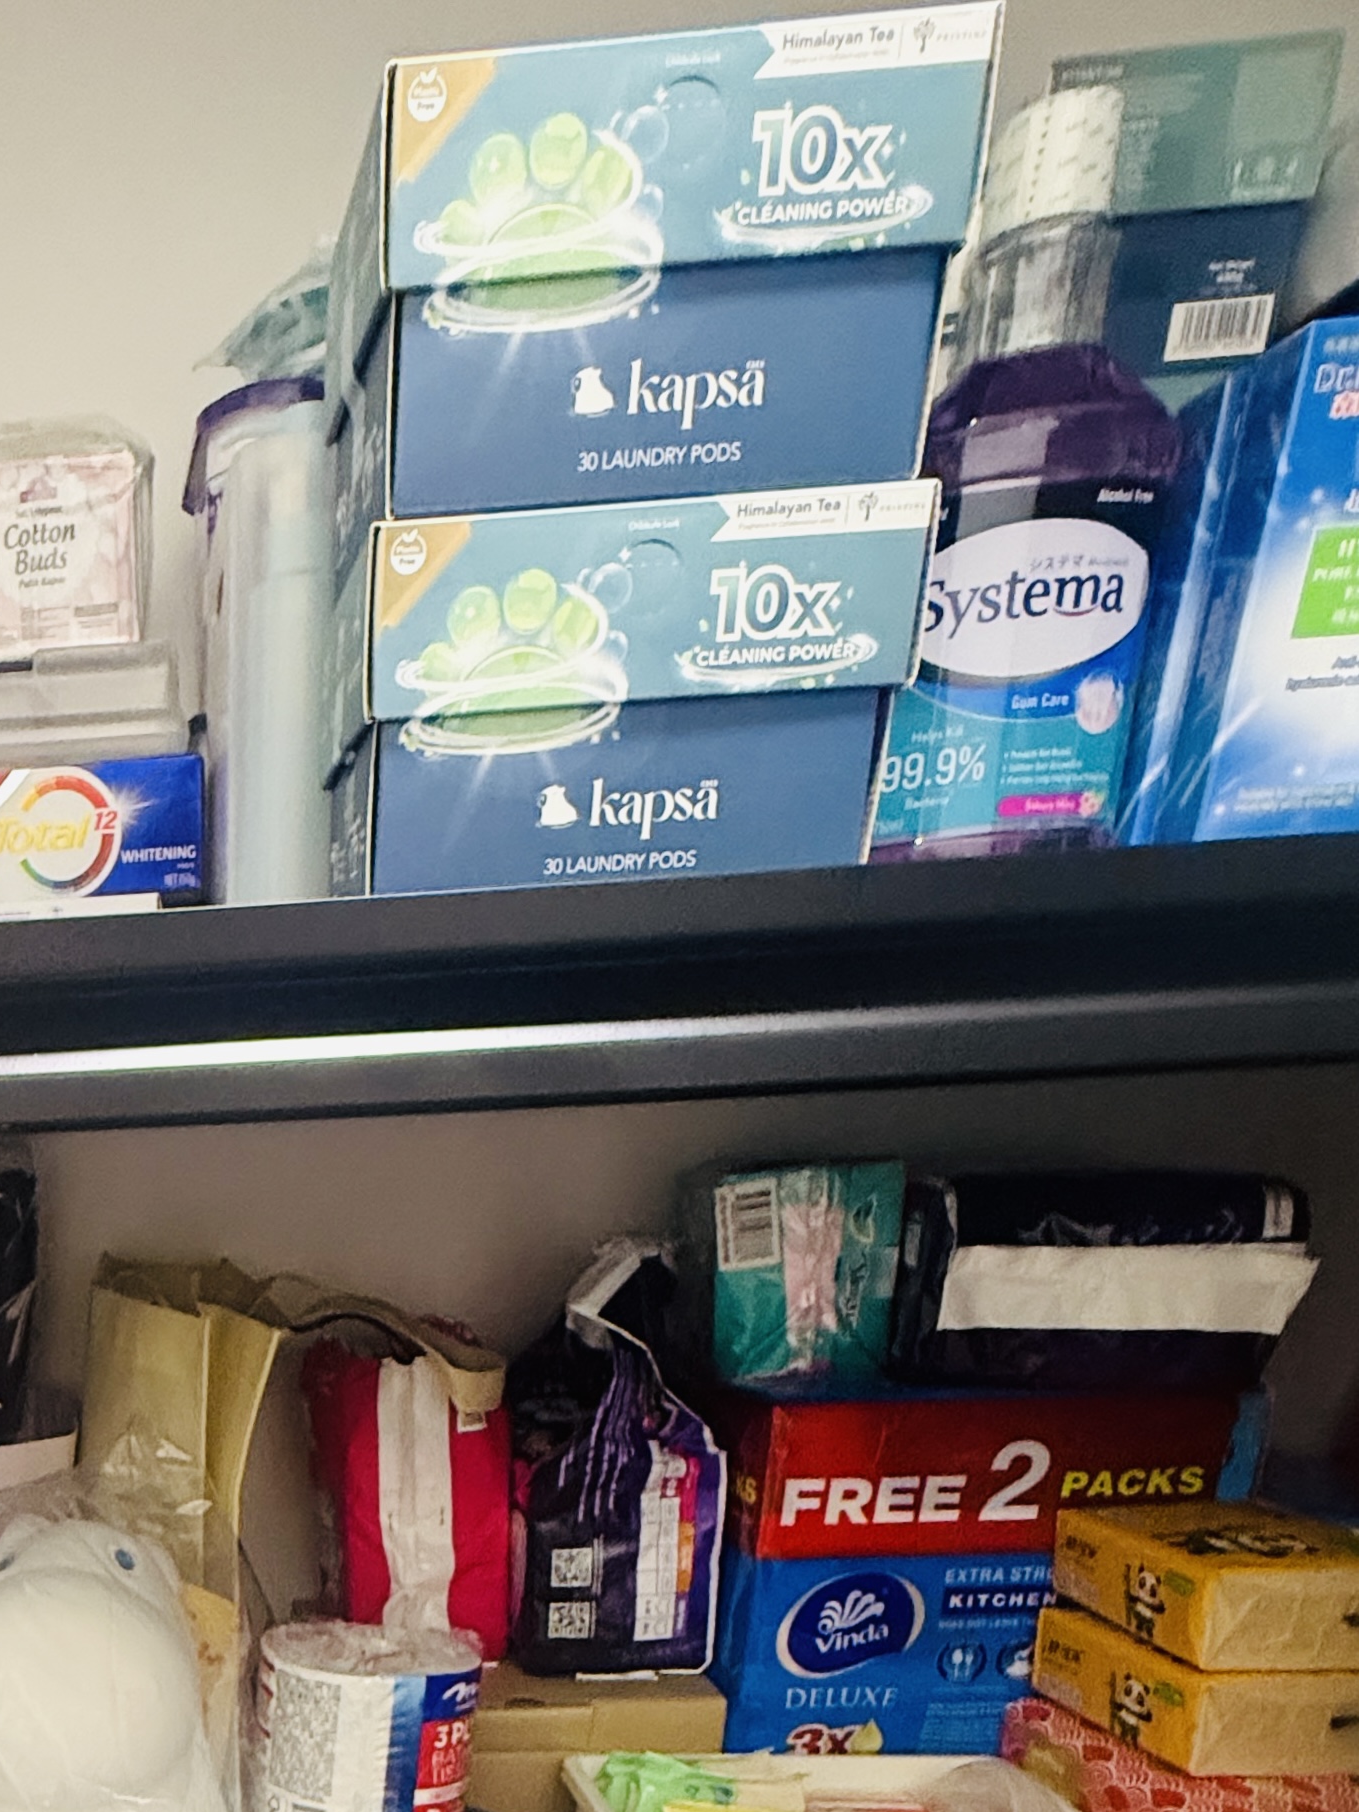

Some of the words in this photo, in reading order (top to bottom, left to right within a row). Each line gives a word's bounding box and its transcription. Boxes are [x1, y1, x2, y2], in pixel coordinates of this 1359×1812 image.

[782, 29, 863, 50] Himalayan
[869, 26, 895, 43] Tea
[752, 105, 893, 197] 10x
[737, 202, 833, 225] CLEANING
[836, 196, 910, 219] POWER
[577, 451, 599, 472] 30
[601, 445, 688, 471] LAUNDRY
[690, 441, 742, 464] PODS
[737, 499, 812, 519] Himalayan
[818, 498, 841, 511] Tea
[4, 523, 76, 550] Cotton
[14, 547, 67, 575] Buds
[710, 564, 842, 642] 10x
[924, 570, 1124, 640] Systema
[696, 647, 786, 667] CLEANING
[789, 641, 859, 661] POWER
[1011, 694, 1038, 710] Gum
[1041, 693, 1070, 708] Care
[881, 744, 986, 793] 99.9%
[94, 810, 118, 832] 12
[121, 845, 196, 864] WHITENING
[543, 858, 563, 876] 30
[566, 852, 647, 875] LAUNDRY
[648, 849, 697, 869] PODS
[780, 1475, 967, 1526] FREE
[978, 1439, 1051, 1522] 2
[1061, 1466, 1205, 1498] PACKS
[945, 1566, 1003, 1583] EXTRA
[949, 1592, 1057, 1608] KITCHEN
[815, 1622, 889, 1653] Vinda
[785, 1687, 898, 1709] DELUXE
[433, 1725, 449, 1748] 3
